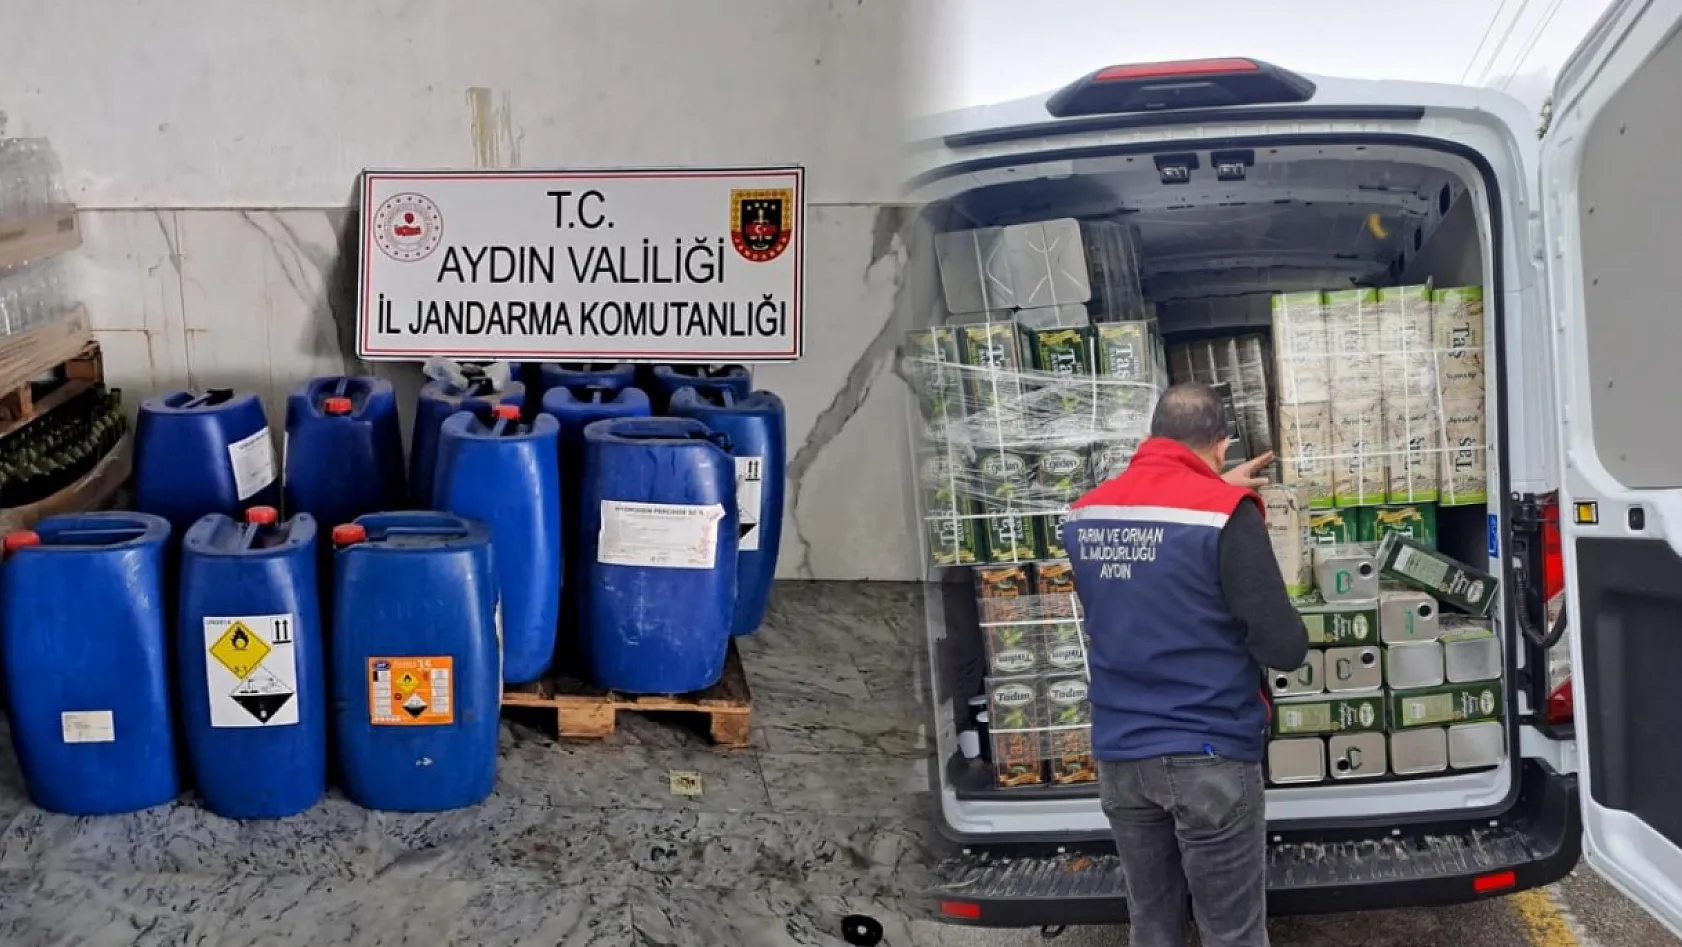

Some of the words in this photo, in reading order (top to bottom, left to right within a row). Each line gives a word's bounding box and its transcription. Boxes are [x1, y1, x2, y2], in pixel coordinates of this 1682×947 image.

[547, 190, 615, 229] T.C.
[437, 245, 555, 284] AYDIN
[568, 237, 725, 285] VALİLİĞİ
[378, 293, 401, 334] İL
[408, 300, 571, 336] JANDARMA
[580, 292, 786, 337] KOMUTANLIĞI
[1078, 528, 1105, 543] TARIM
[1105, 528, 1120, 542] VE
[1122, 527, 1164, 544] ORMAN
[1100, 563, 1132, 579] AYDIN
